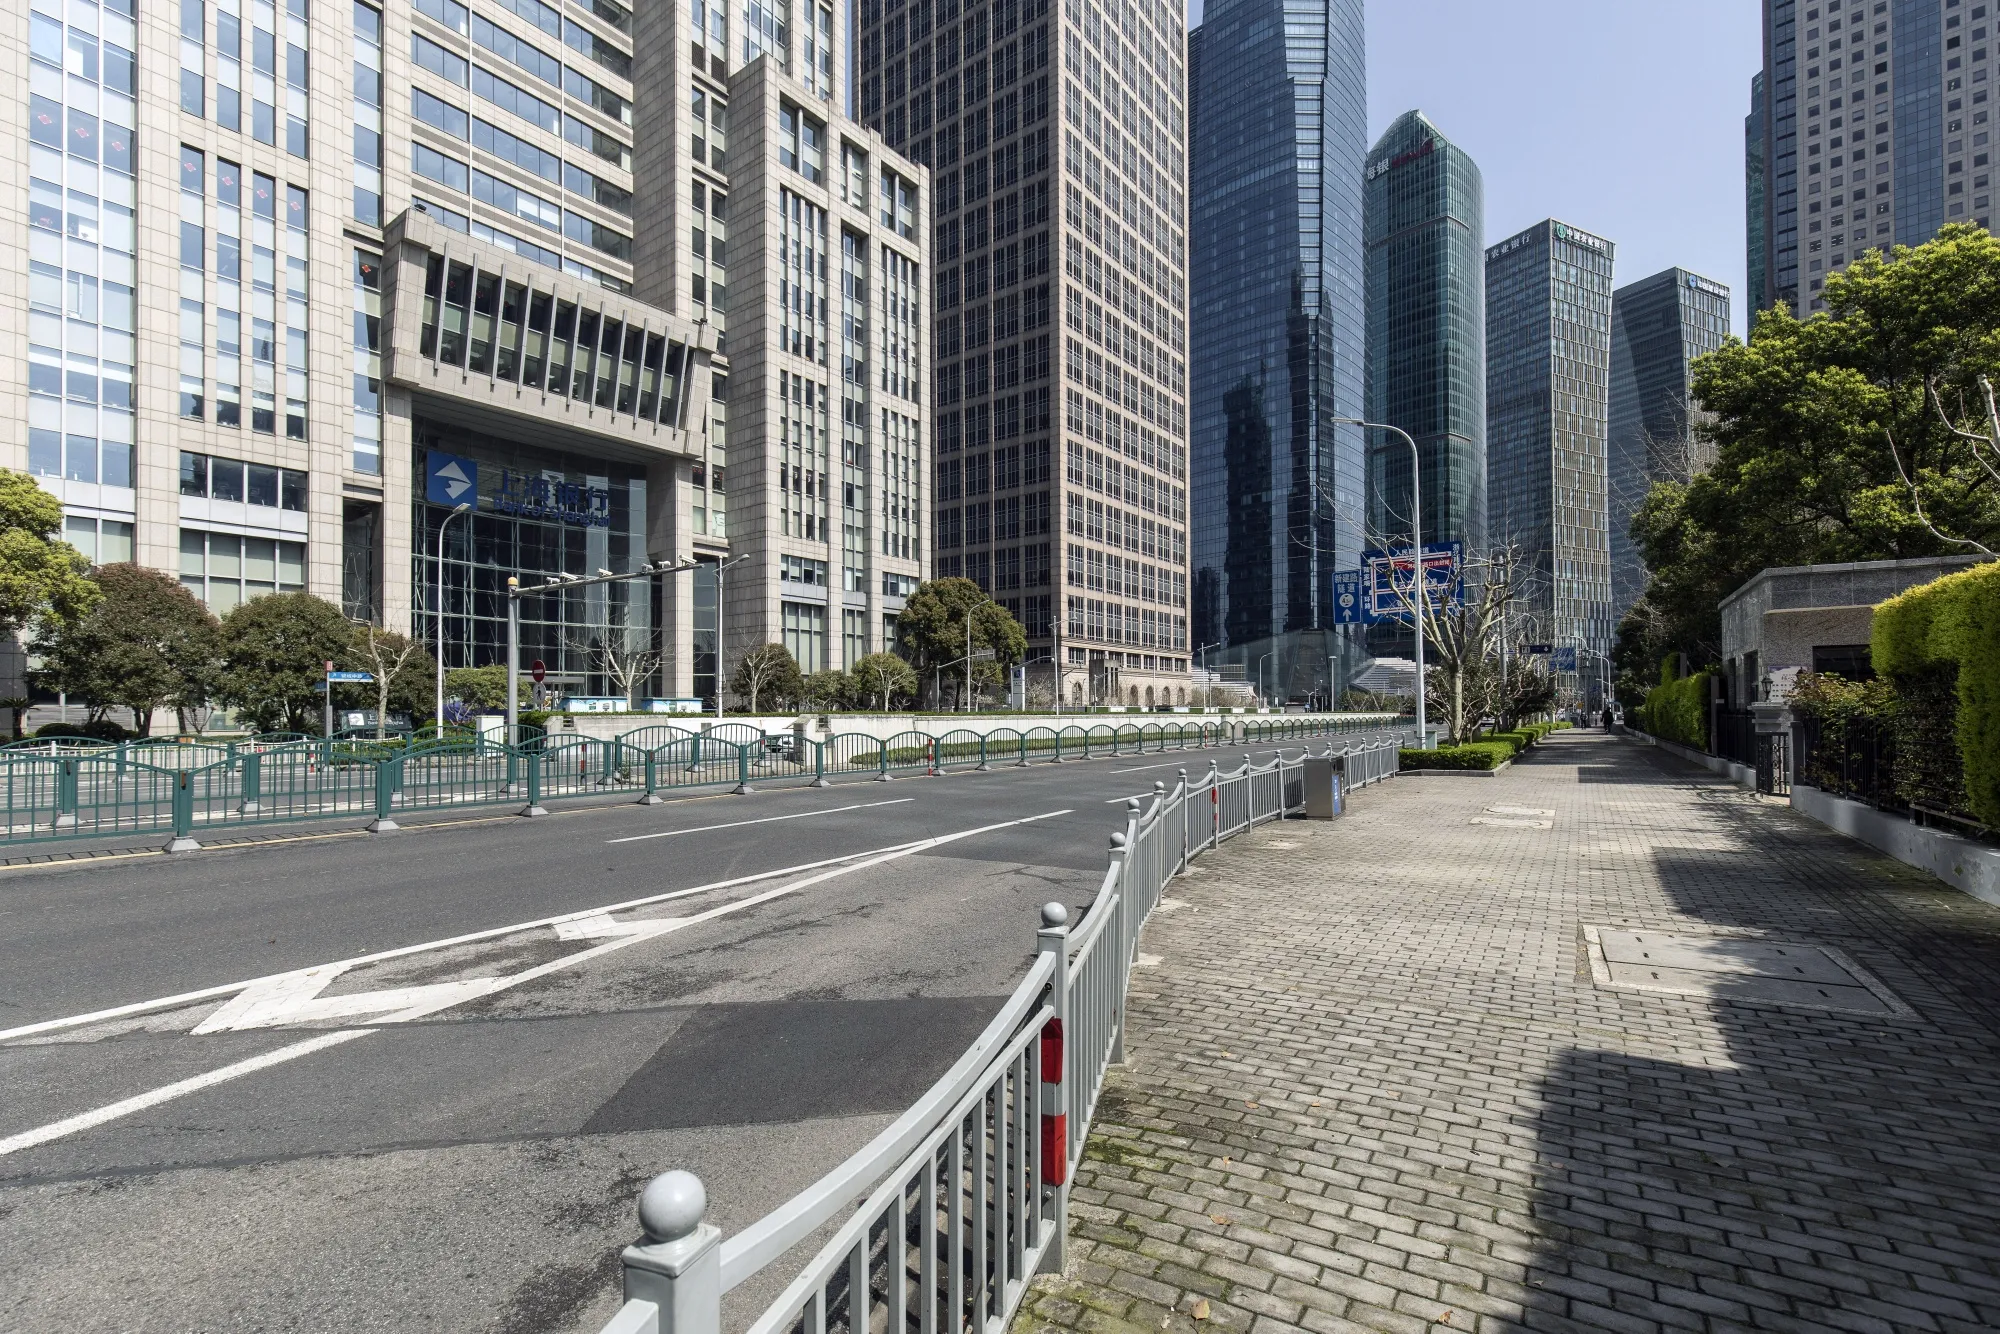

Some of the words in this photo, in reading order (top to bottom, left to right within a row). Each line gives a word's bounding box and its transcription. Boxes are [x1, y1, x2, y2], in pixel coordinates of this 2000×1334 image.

[1566, 228, 1607, 250] 中国农业银行
[493, 469, 608, 511] 上海银行
[493, 496, 528, 515] Bank
[530, 503, 546, 517] of
[550, 506, 611, 528] Shanghai
[1335, 572, 1359, 583] 新建路
[1337, 583, 1355, 594] 隧道
